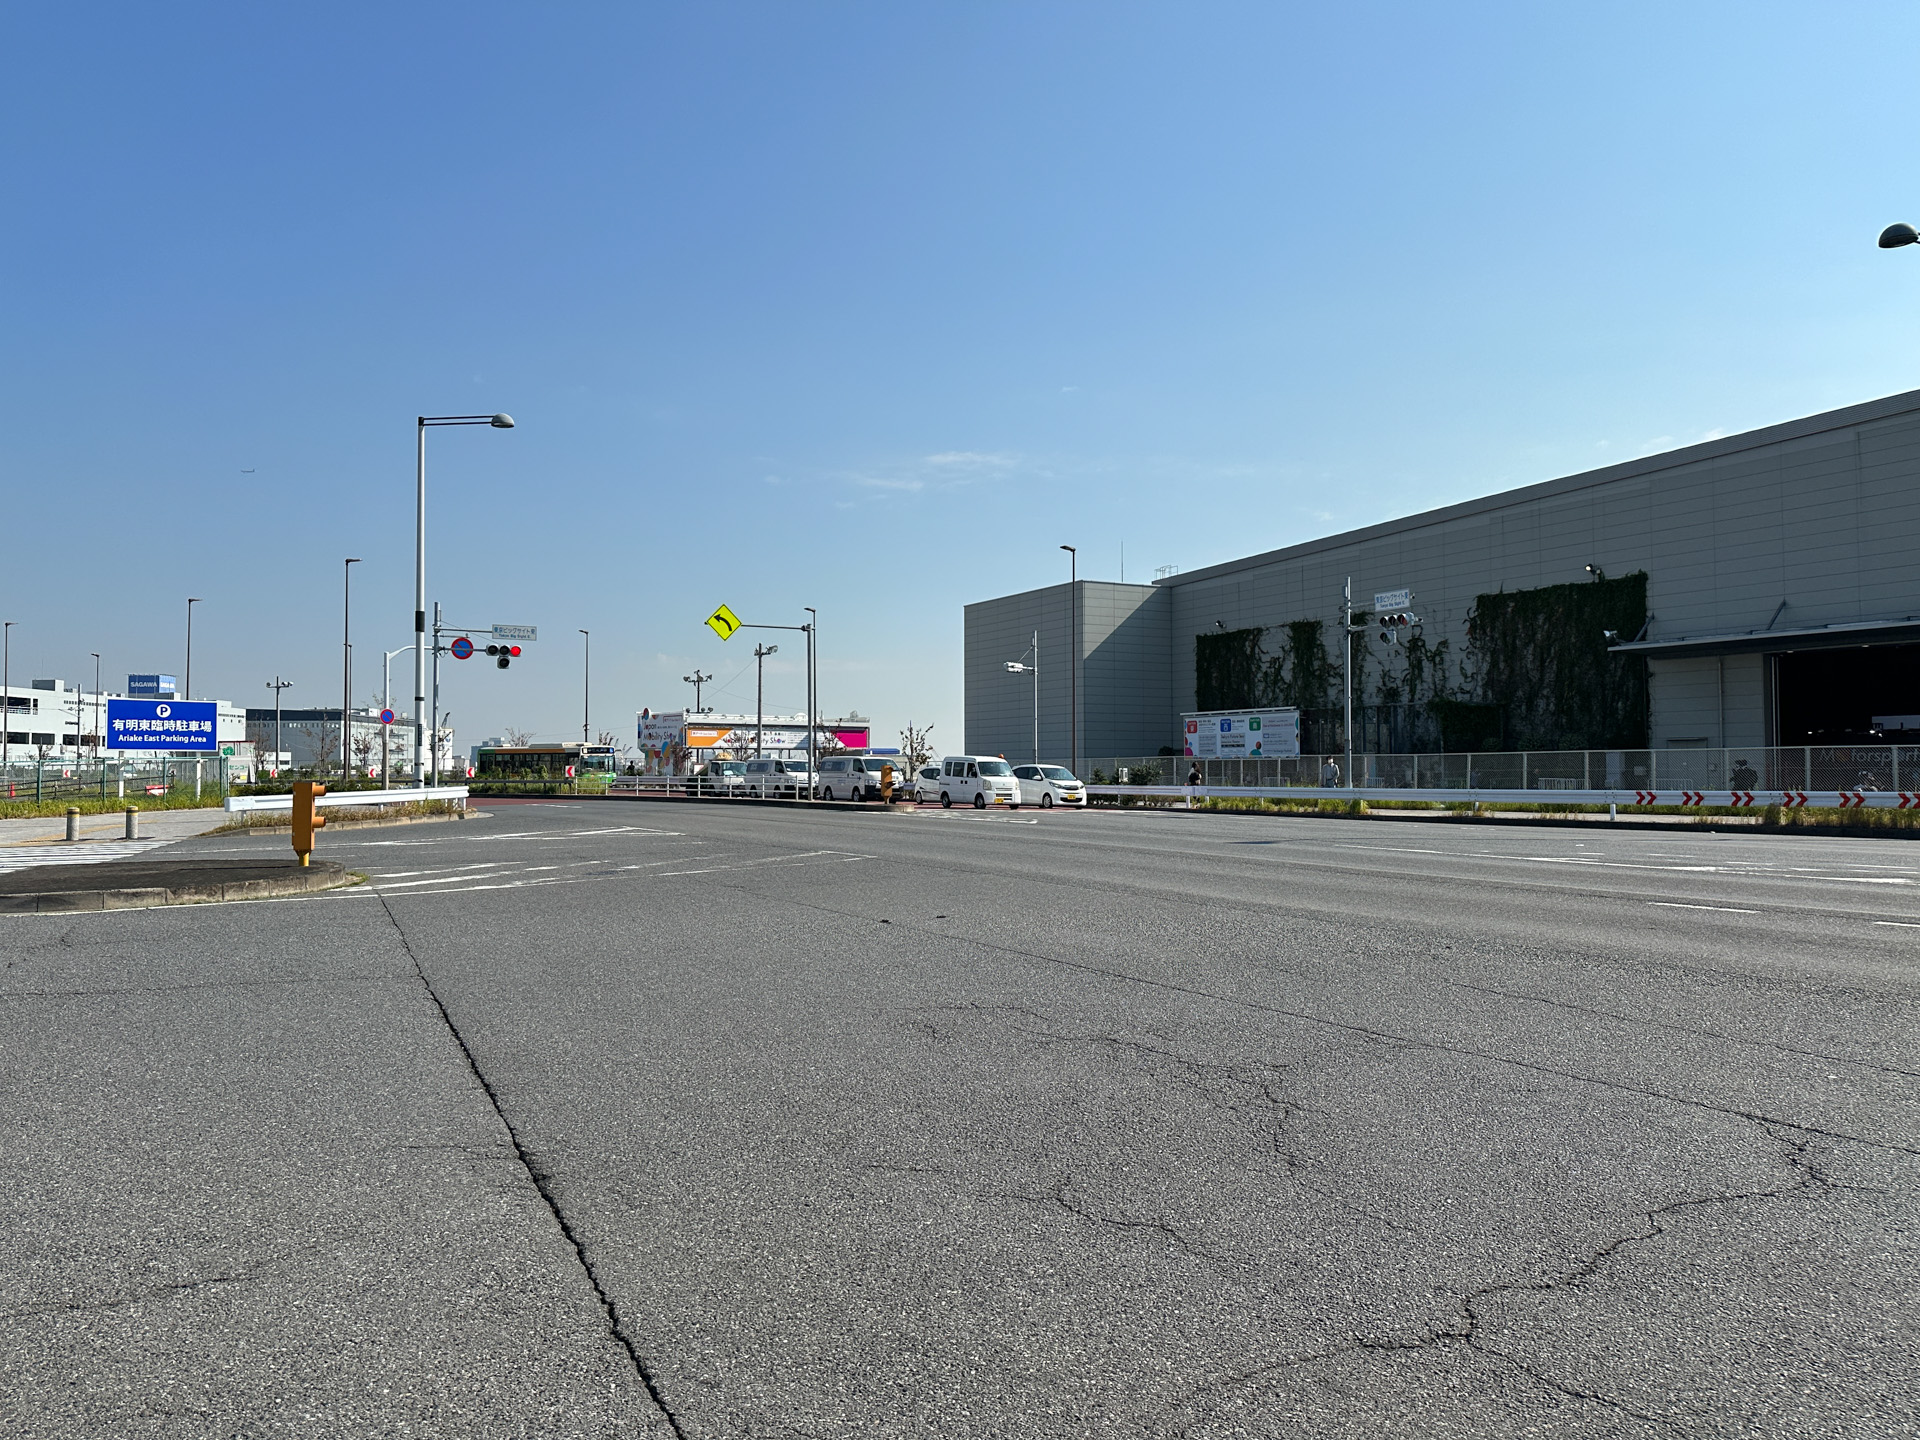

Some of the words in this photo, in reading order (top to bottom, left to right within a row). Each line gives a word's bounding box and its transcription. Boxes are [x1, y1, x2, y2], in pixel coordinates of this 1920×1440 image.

[112, 718, 212, 732] 有明東臨時駐車場
[118, 734, 143, 742] Ariake
[160, 735, 189, 743] Parking
